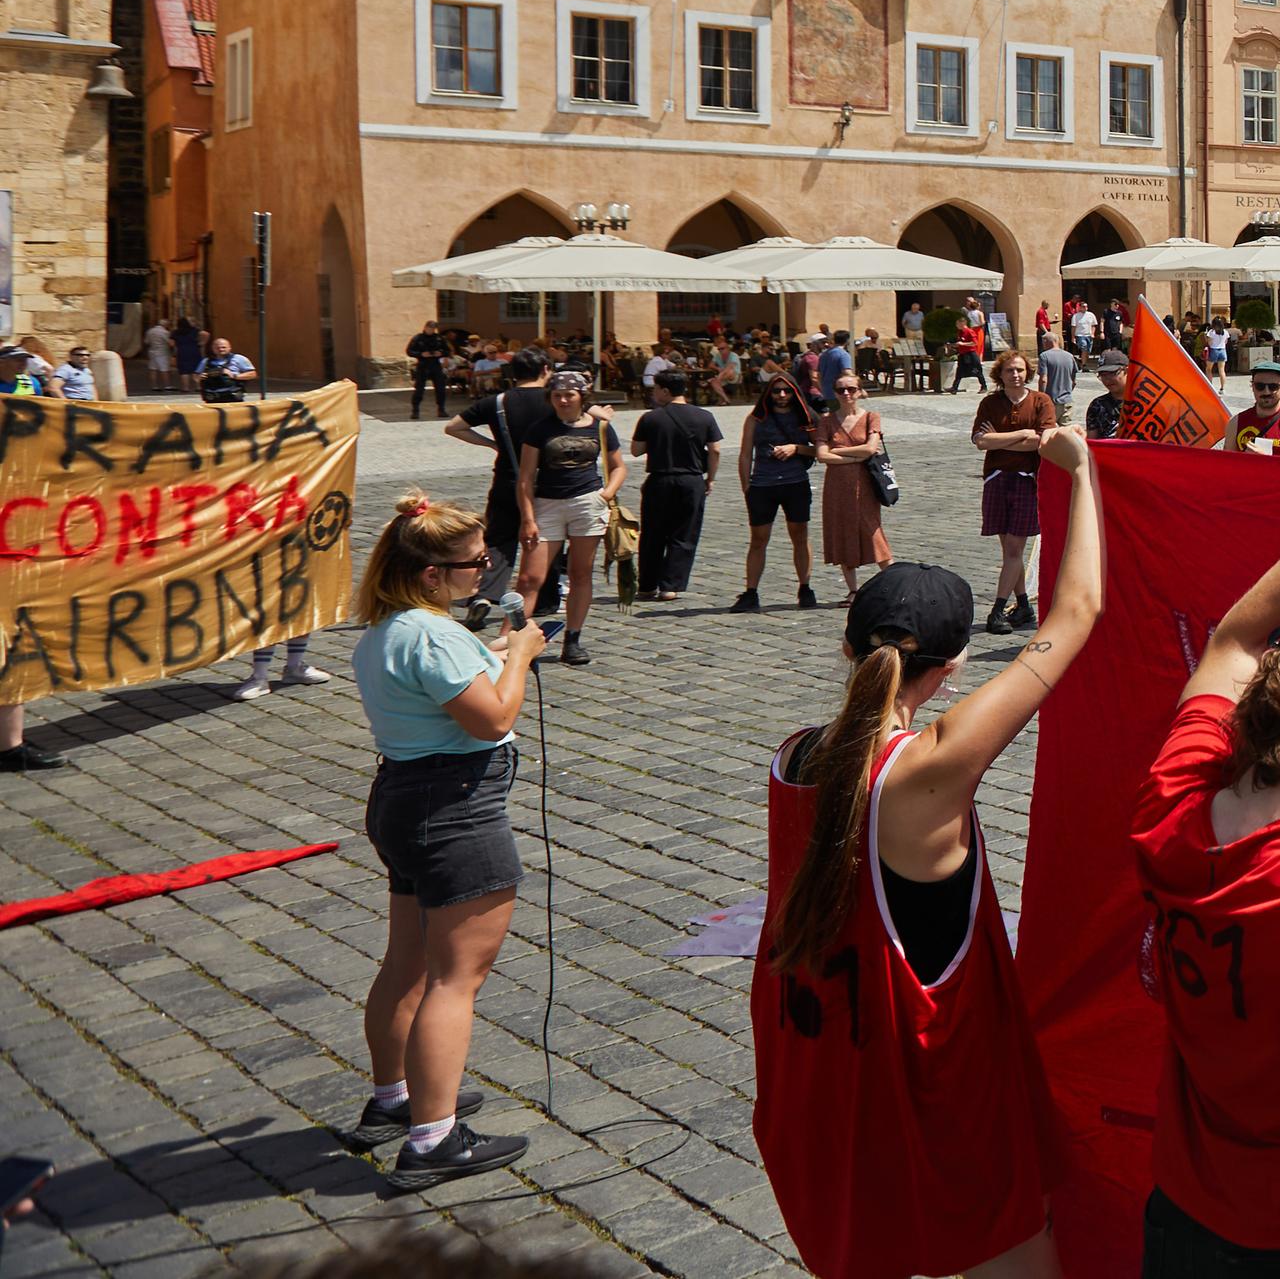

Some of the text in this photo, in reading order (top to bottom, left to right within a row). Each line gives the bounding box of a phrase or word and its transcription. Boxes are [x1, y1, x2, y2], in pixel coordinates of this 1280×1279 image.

[1103, 176, 1165, 187] RISTORANTE
[1102, 191, 1171, 202] CAFFE ITALIA
[614, 279, 677, 288] RISTORANTE
[880, 280, 930, 288] RISTORANTE
[0, 400, 330, 473] PRAHA
[0, 476, 309, 566] CONTRA
[0, 533, 312, 688] AIRBNB
